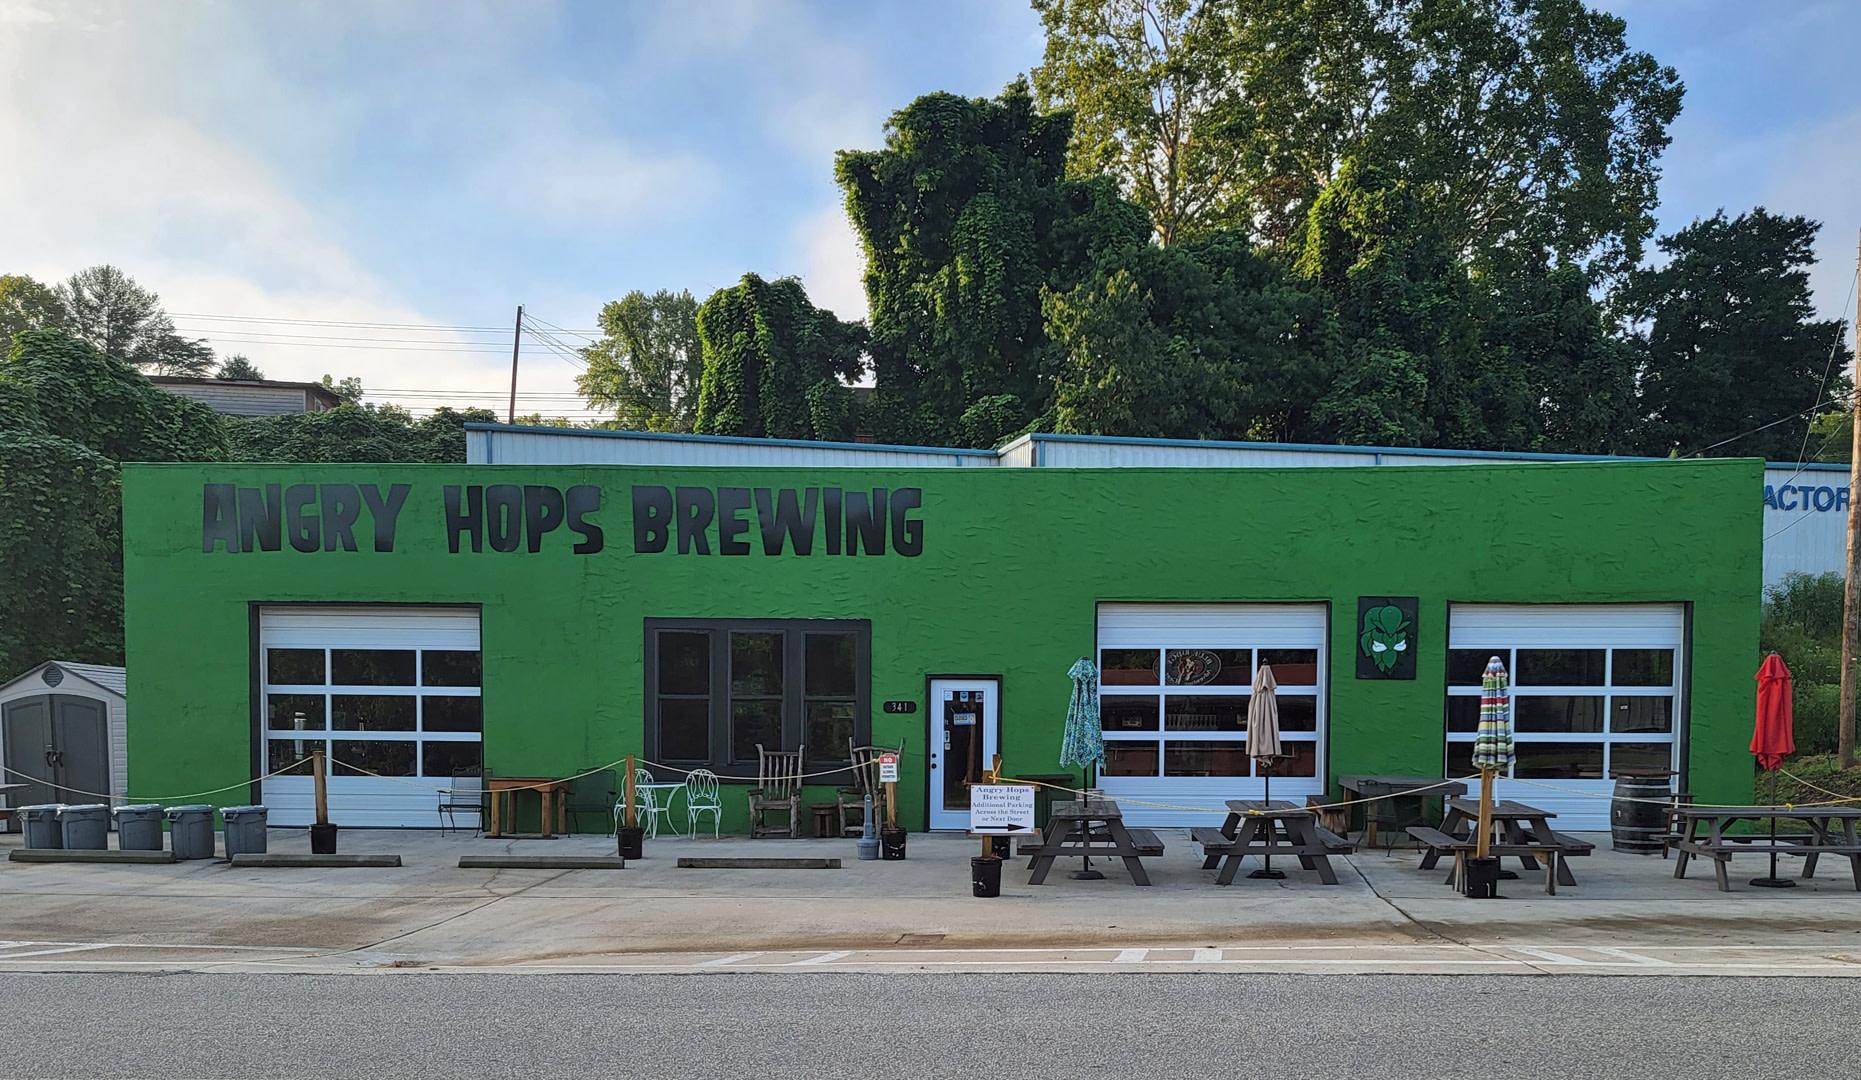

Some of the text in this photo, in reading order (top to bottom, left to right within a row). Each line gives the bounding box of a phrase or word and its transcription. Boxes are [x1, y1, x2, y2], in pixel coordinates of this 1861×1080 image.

[202, 483, 924, 557] ANGRY HOPS BREWING
[891, 702, 908, 712] 341
